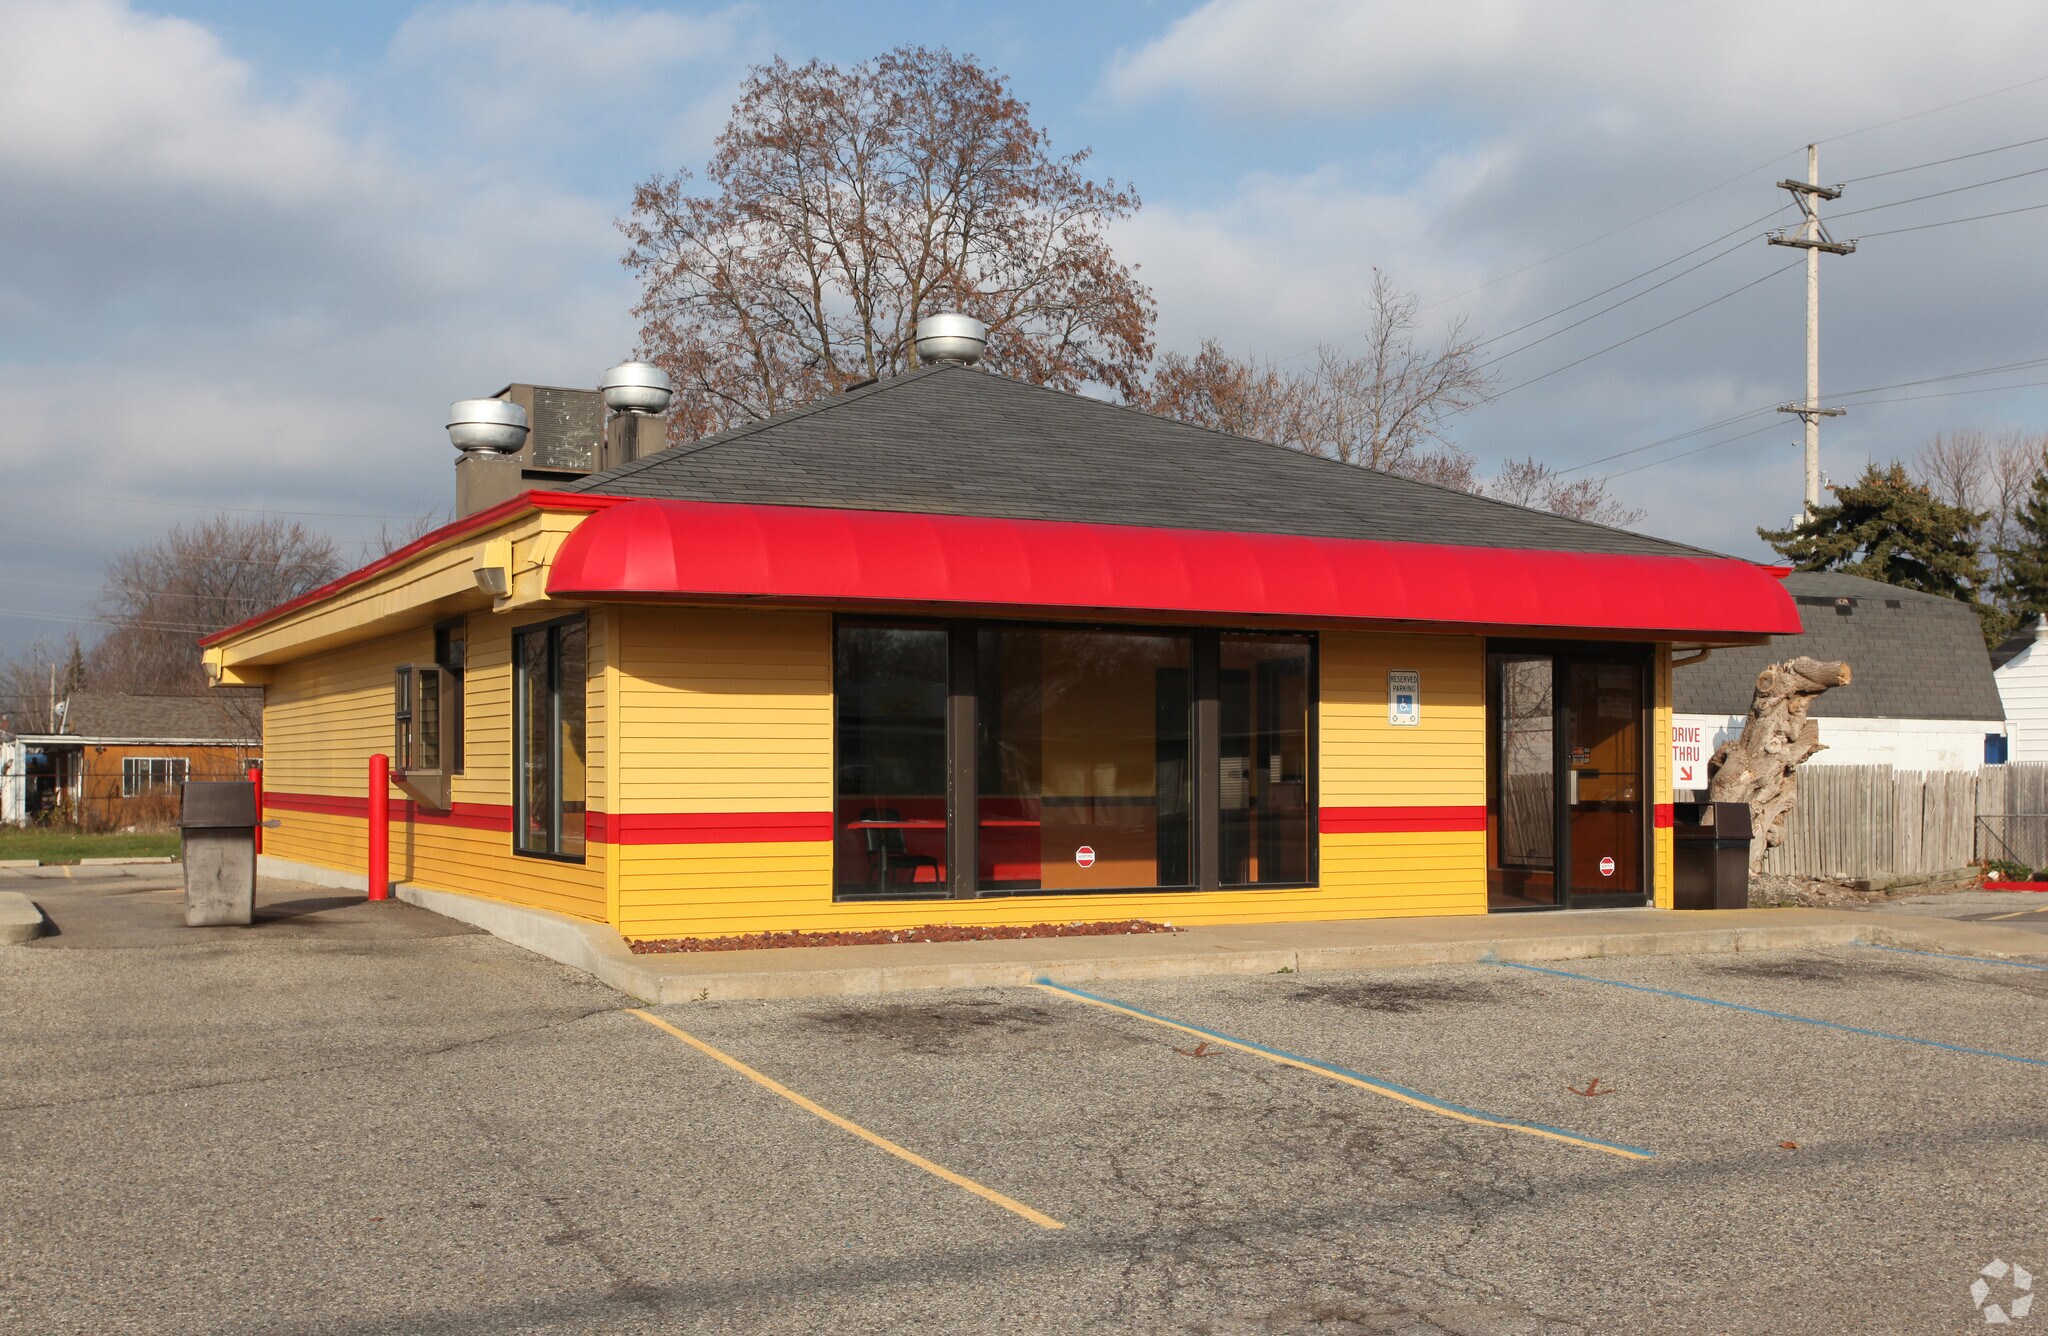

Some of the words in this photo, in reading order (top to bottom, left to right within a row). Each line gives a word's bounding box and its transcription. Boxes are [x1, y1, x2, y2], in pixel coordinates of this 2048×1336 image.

[1390, 675, 1418, 683] RESERVED
[1672, 727, 1700, 742] DRIVE
[1672, 746, 1700, 761] THRU
